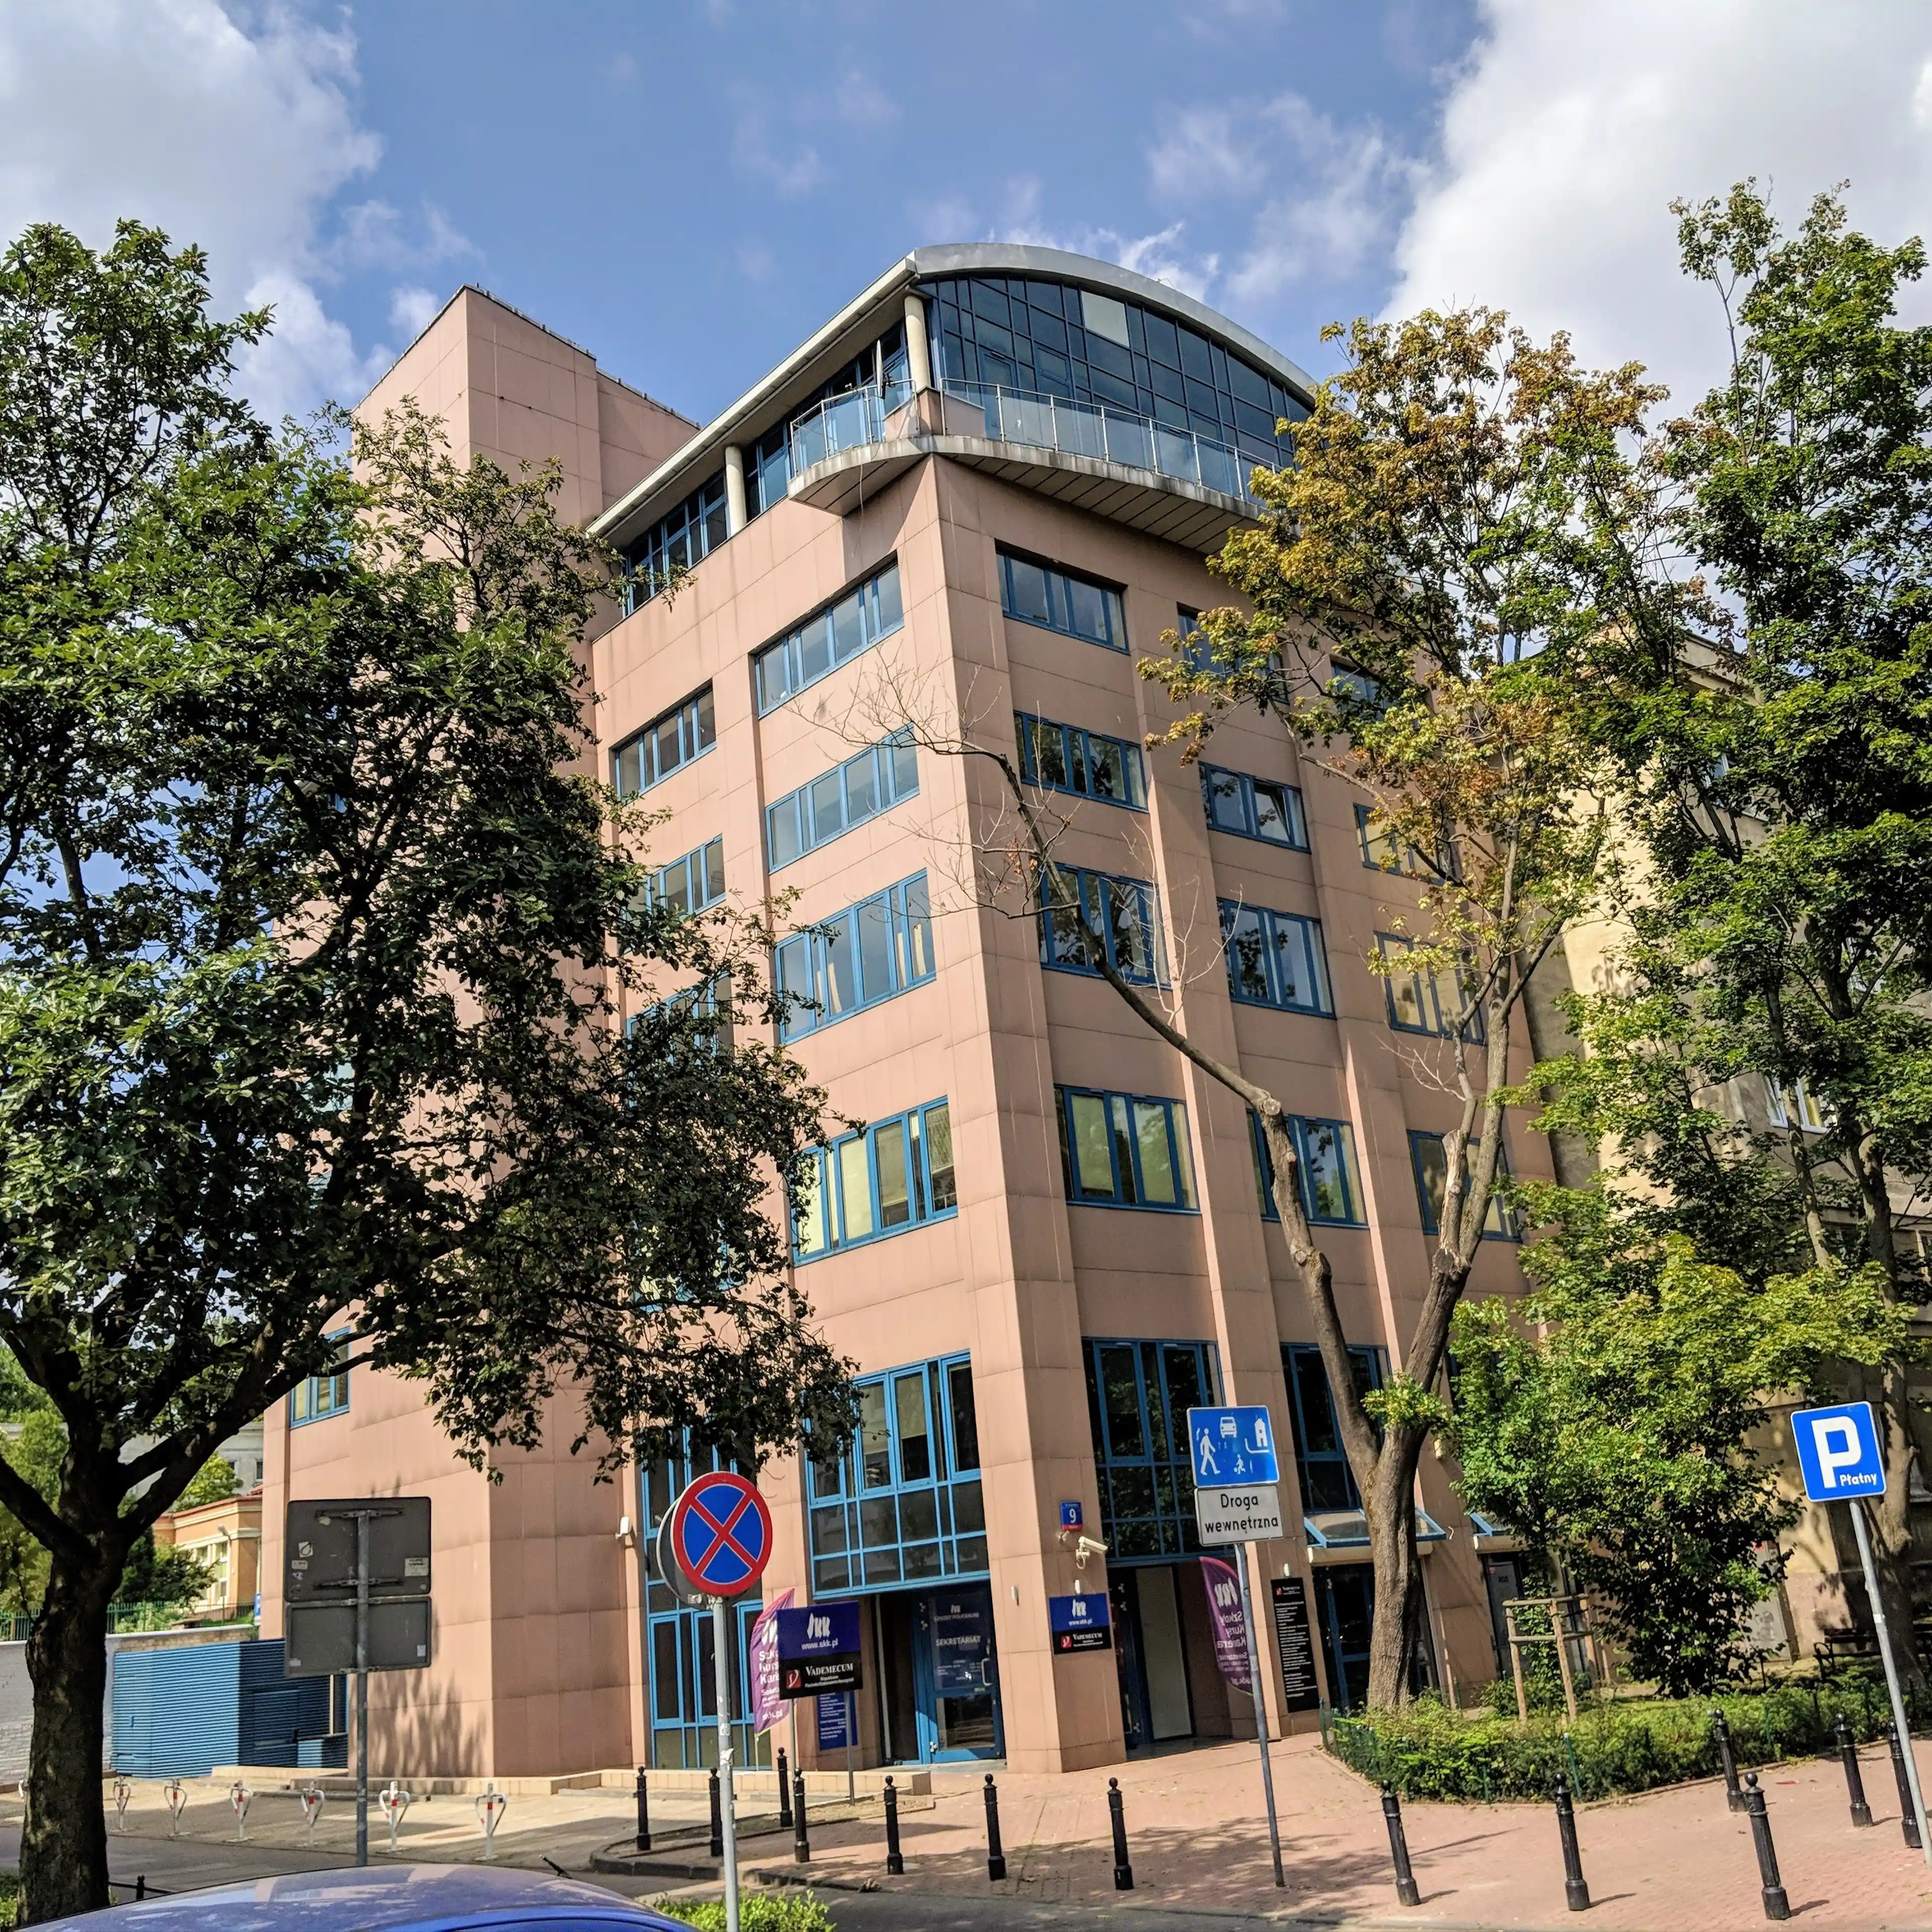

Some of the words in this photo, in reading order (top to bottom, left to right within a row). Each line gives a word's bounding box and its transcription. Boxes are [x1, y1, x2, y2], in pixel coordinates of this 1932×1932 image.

[1811, 1416, 1862, 1489] P
[1839, 1472, 1877, 1487] Płatny
[1221, 1493, 1259, 1510] Droga
[1069, 1508, 1076, 1523] 9
[1205, 1515, 1278, 1534] wewnętrzna
[801, 1638, 838, 1650] www.skk.pl
[936, 1635, 981, 1646] SEKRETARIAT
[806, 1663, 854, 1676] VADEMECUM
